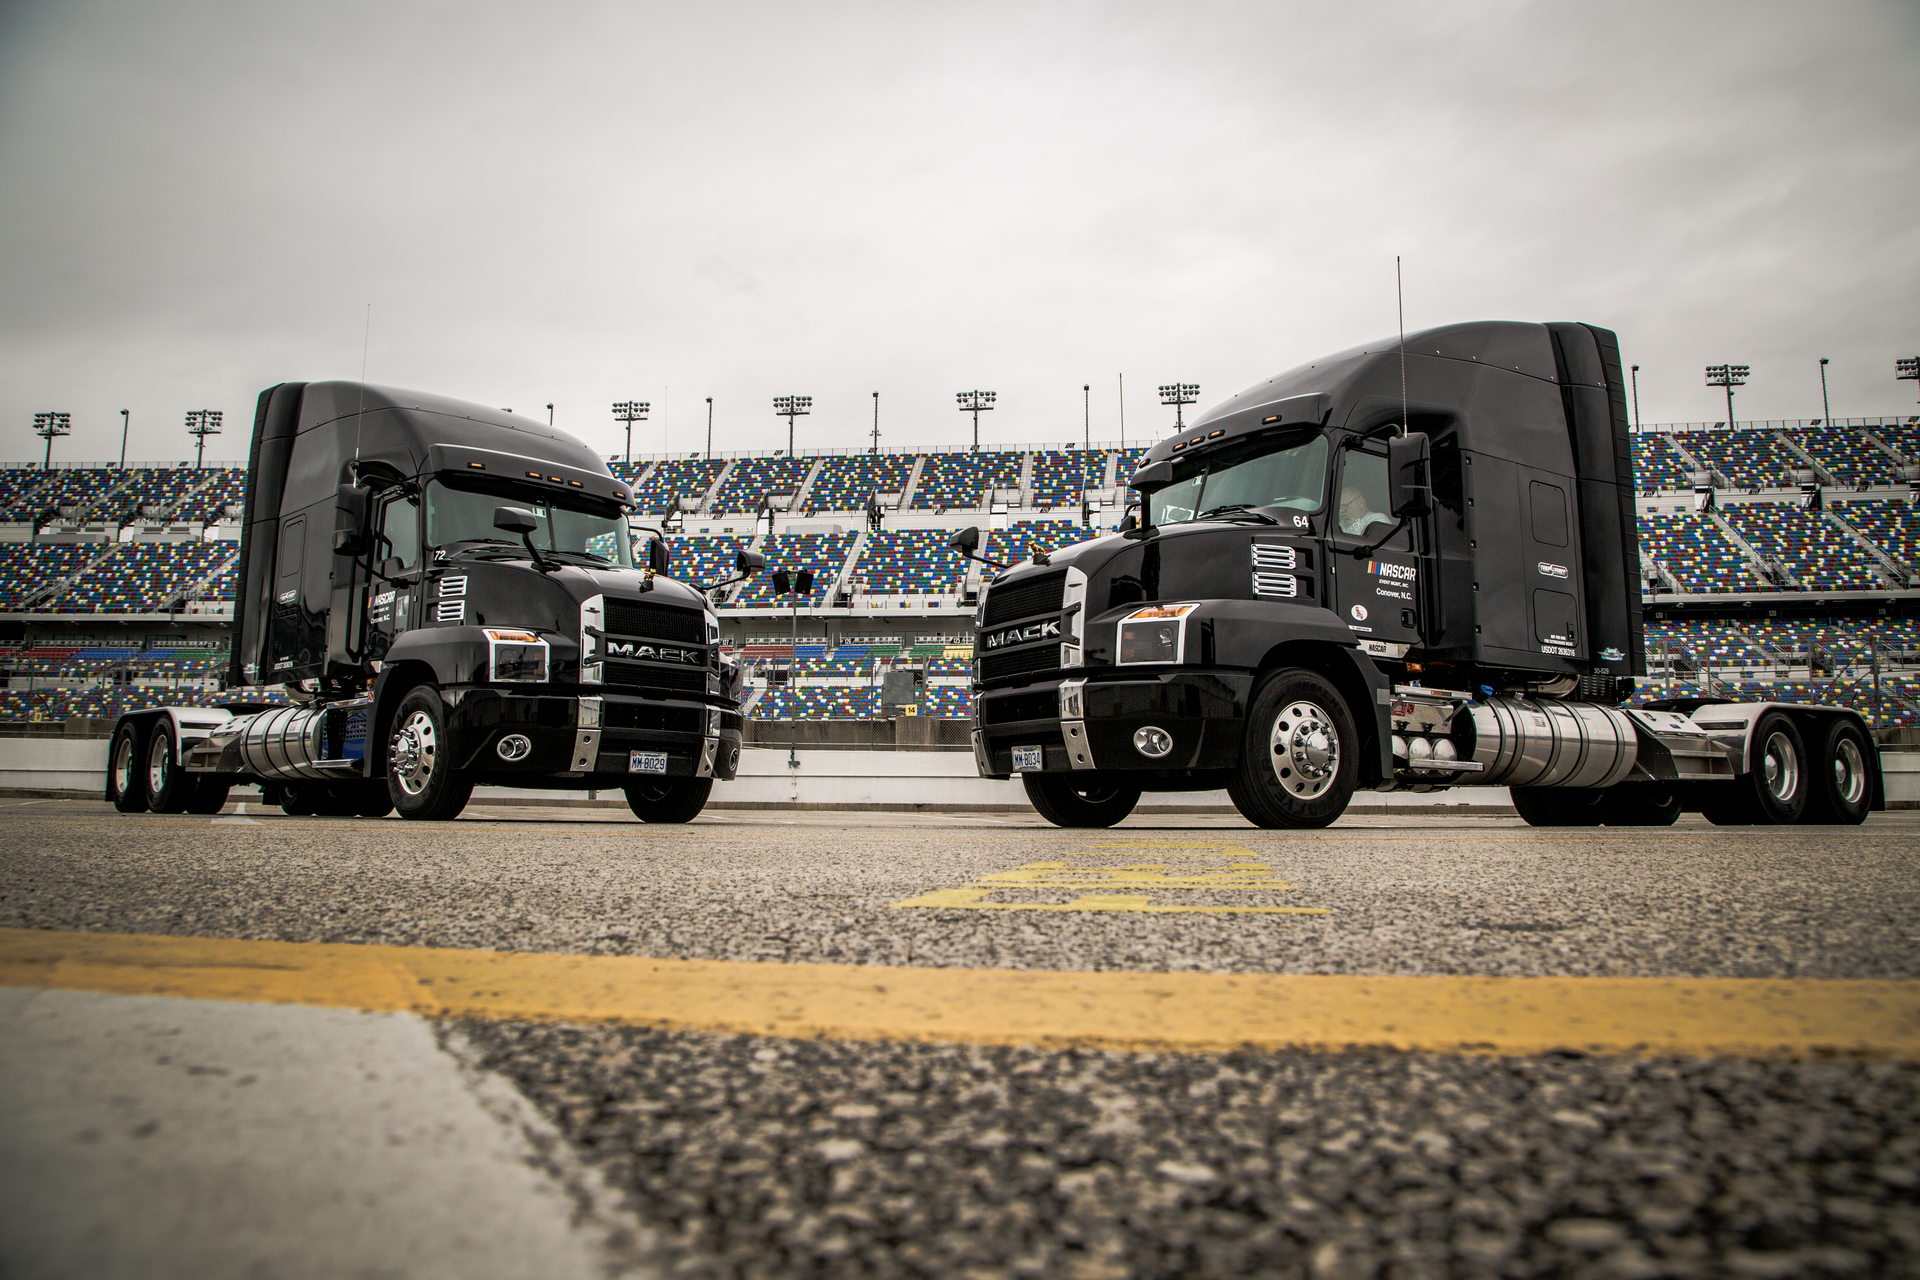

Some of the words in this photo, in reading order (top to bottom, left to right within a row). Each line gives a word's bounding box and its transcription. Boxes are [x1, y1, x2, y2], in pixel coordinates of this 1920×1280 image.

[1293, 515, 1309, 527] 64
[434, 550, 446, 561] 72
[1379, 562, 1416, 581] NASCAR
[374, 590, 396, 606] NASCAR
[1376, 587, 1400, 599] Conover,
[1401, 591, 1413, 600] N.C.
[986, 620, 1061, 649] MACK
[607, 642, 700, 665] MACK
[1368, 643, 1387, 653] NASCAR
[1541, 645, 1558, 655] USDOT
[907, 706, 915, 714] 14
[631, 756, 665, 770] MM-8029
[1014, 752, 1040, 766] MM-8034
